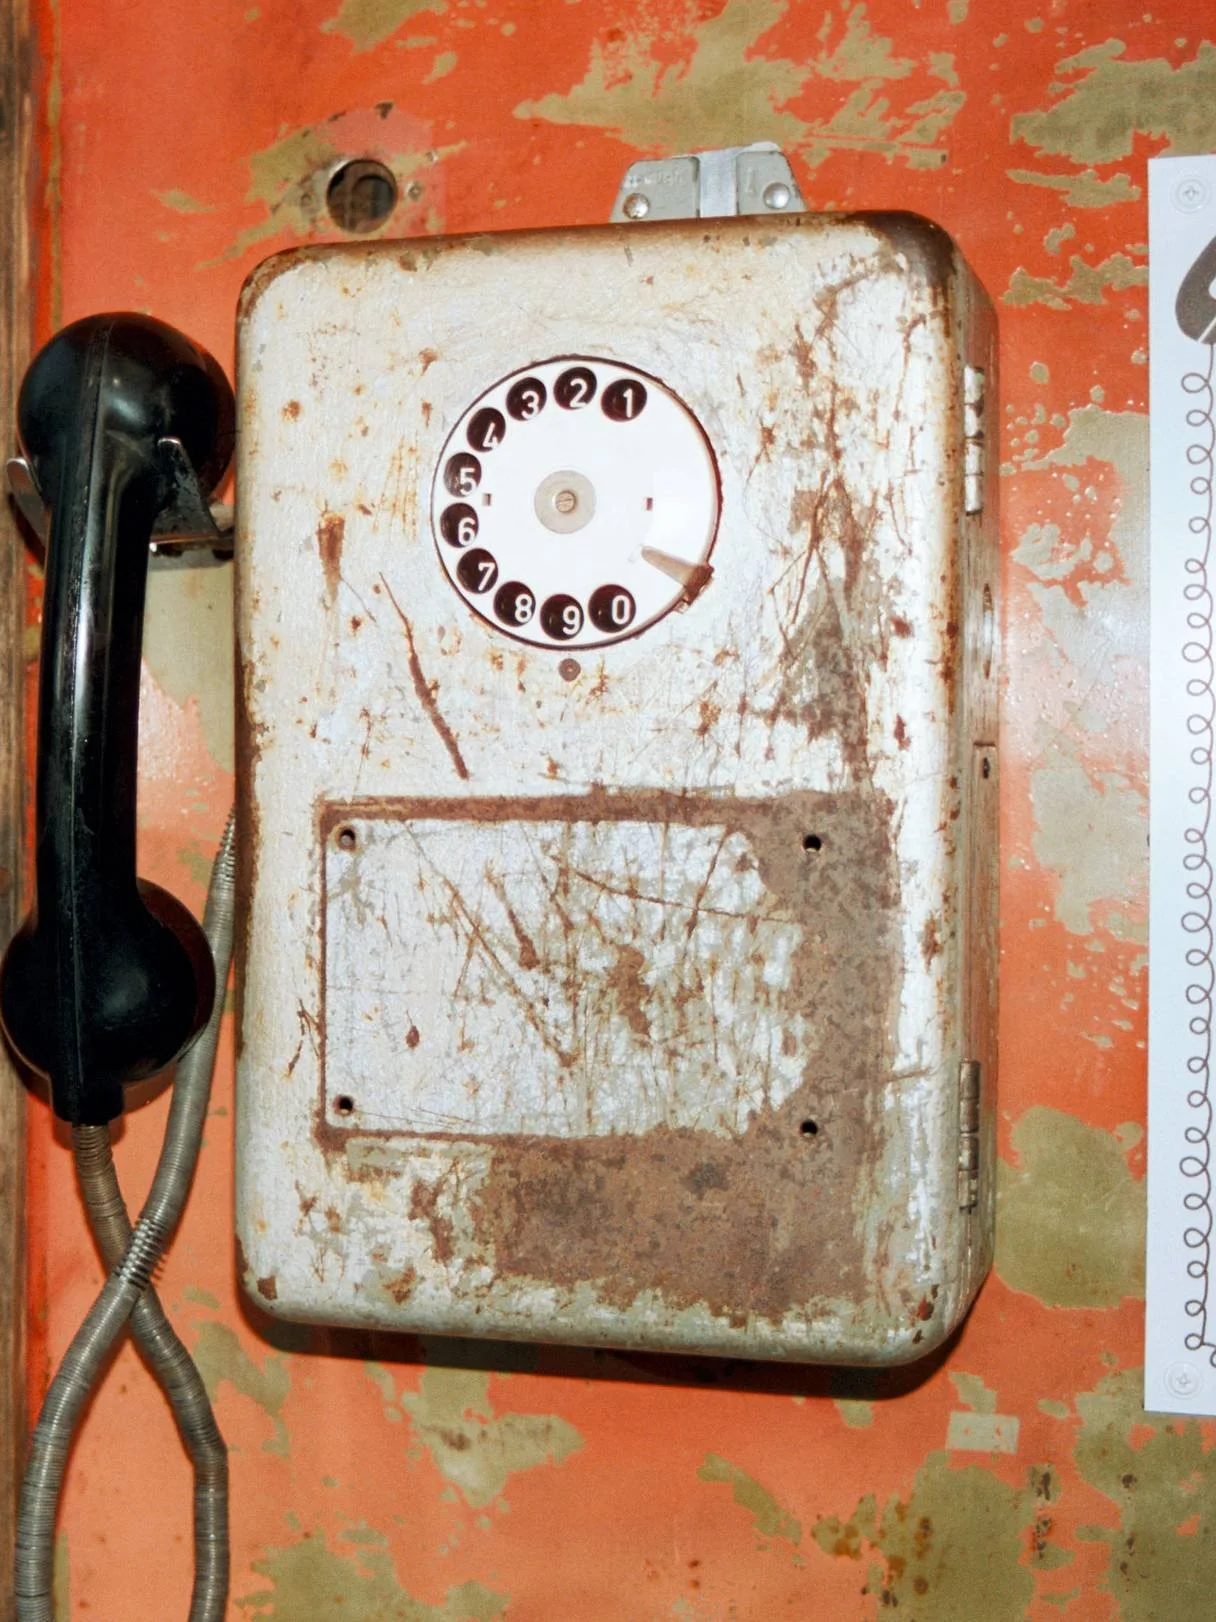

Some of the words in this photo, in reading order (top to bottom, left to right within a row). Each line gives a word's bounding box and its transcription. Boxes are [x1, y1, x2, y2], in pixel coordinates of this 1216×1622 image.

[521, 390, 540, 420] 3
[569, 378, 588, 409] 2
[622, 387, 634, 419] 1
[483, 421, 499, 449] 4
[459, 467, 477, 496] 5
[458, 517, 476, 546] 6
[477, 561, 496, 592] 7
[514, 593, 533, 623] 8
[561, 605, 582, 636] 9
[610, 594, 631, 625] 0
